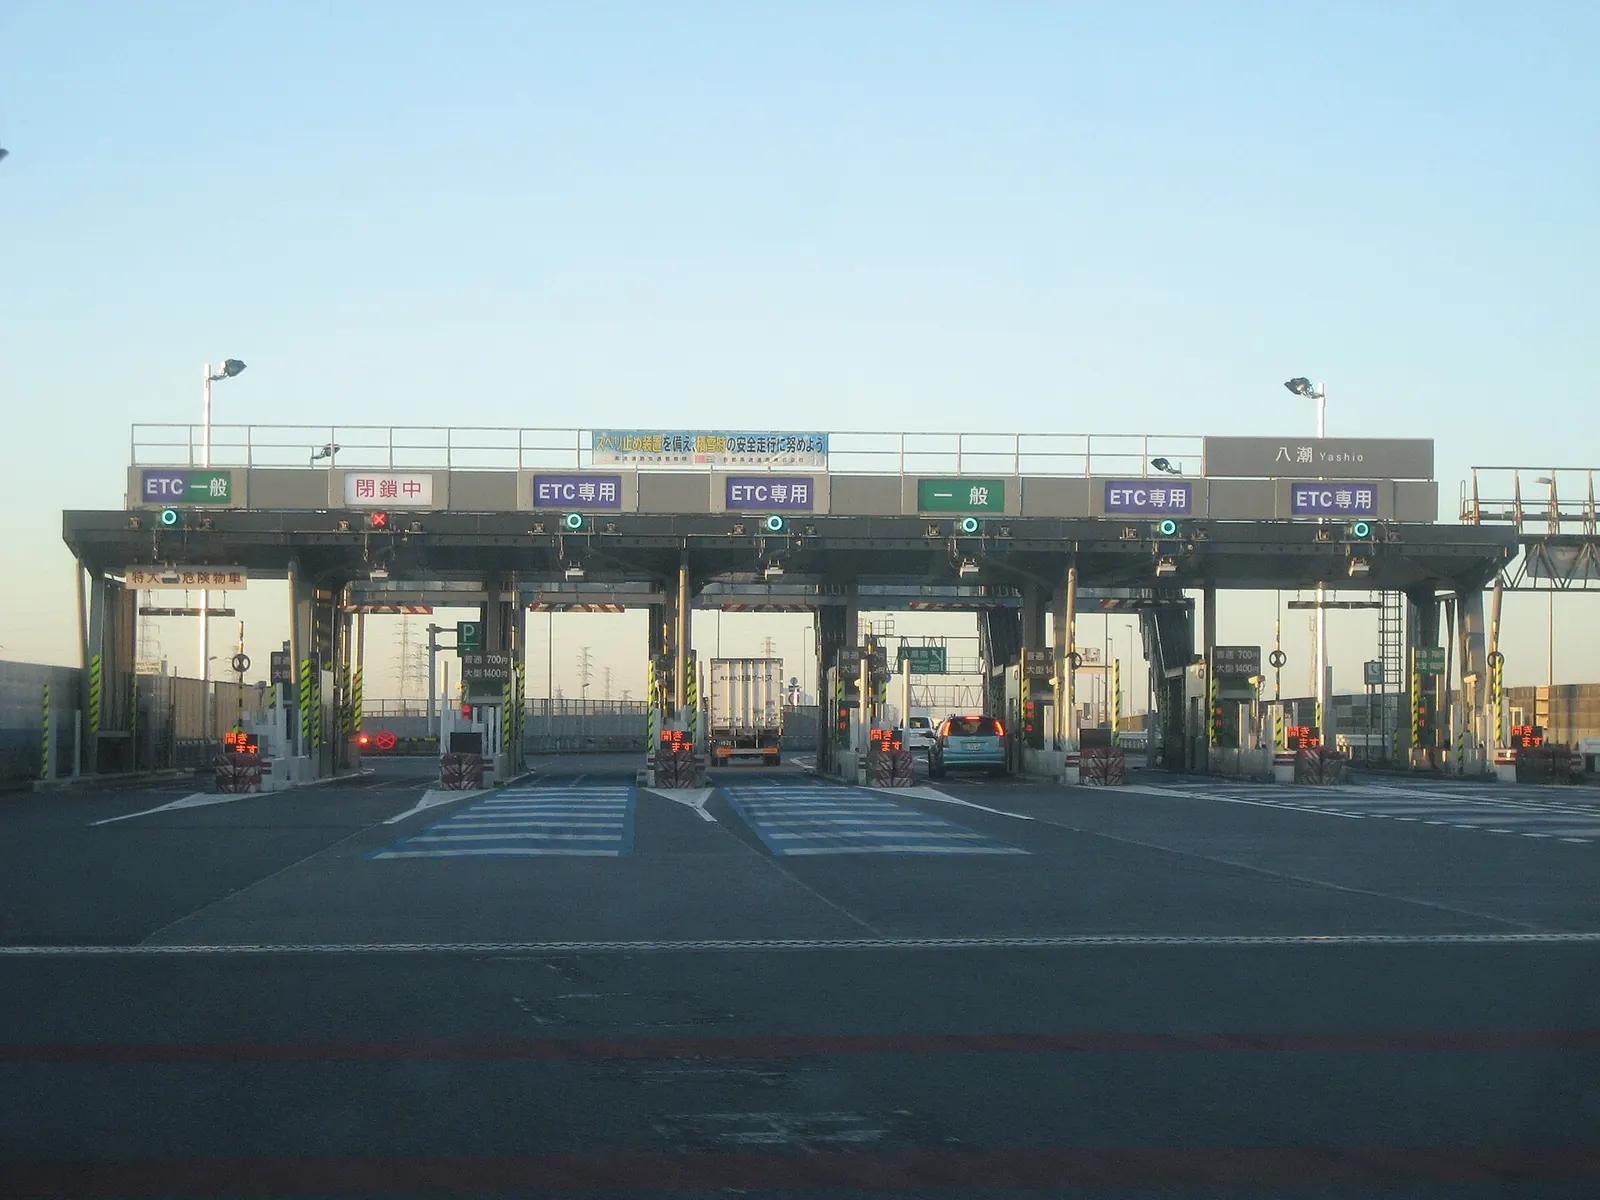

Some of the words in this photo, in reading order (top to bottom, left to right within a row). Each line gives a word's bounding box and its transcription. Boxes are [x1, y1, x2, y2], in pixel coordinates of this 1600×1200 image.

[1275, 446, 1313, 464] 八潮
[1319, 451, 1364, 463] Yashio
[147, 479, 184, 496] ETC
[190, 477, 227, 498] 一般
[356, 479, 422, 498] 閉鎖中
[539, 483, 616, 502] ETC専用
[731, 484, 807, 503] ETC専用
[933, 486, 988, 506] 一般
[1110, 489, 1186, 508] ETC専用
[1296, 490, 1372, 509] ETC専用
[463, 624, 475, 643] P
[661, 730, 683, 741] 開き
[870, 729, 893, 741] 開き
[1288, 726, 1310, 737] 開き
[1512, 725, 1533, 736] 開き
[225, 732, 248, 745] 開き
[1299, 738, 1320, 749] ます
[1522, 737, 1543, 748] ます
[236, 745, 258, 754] ます
[671, 742, 692, 752] ます
[881, 741, 903, 752] ます
